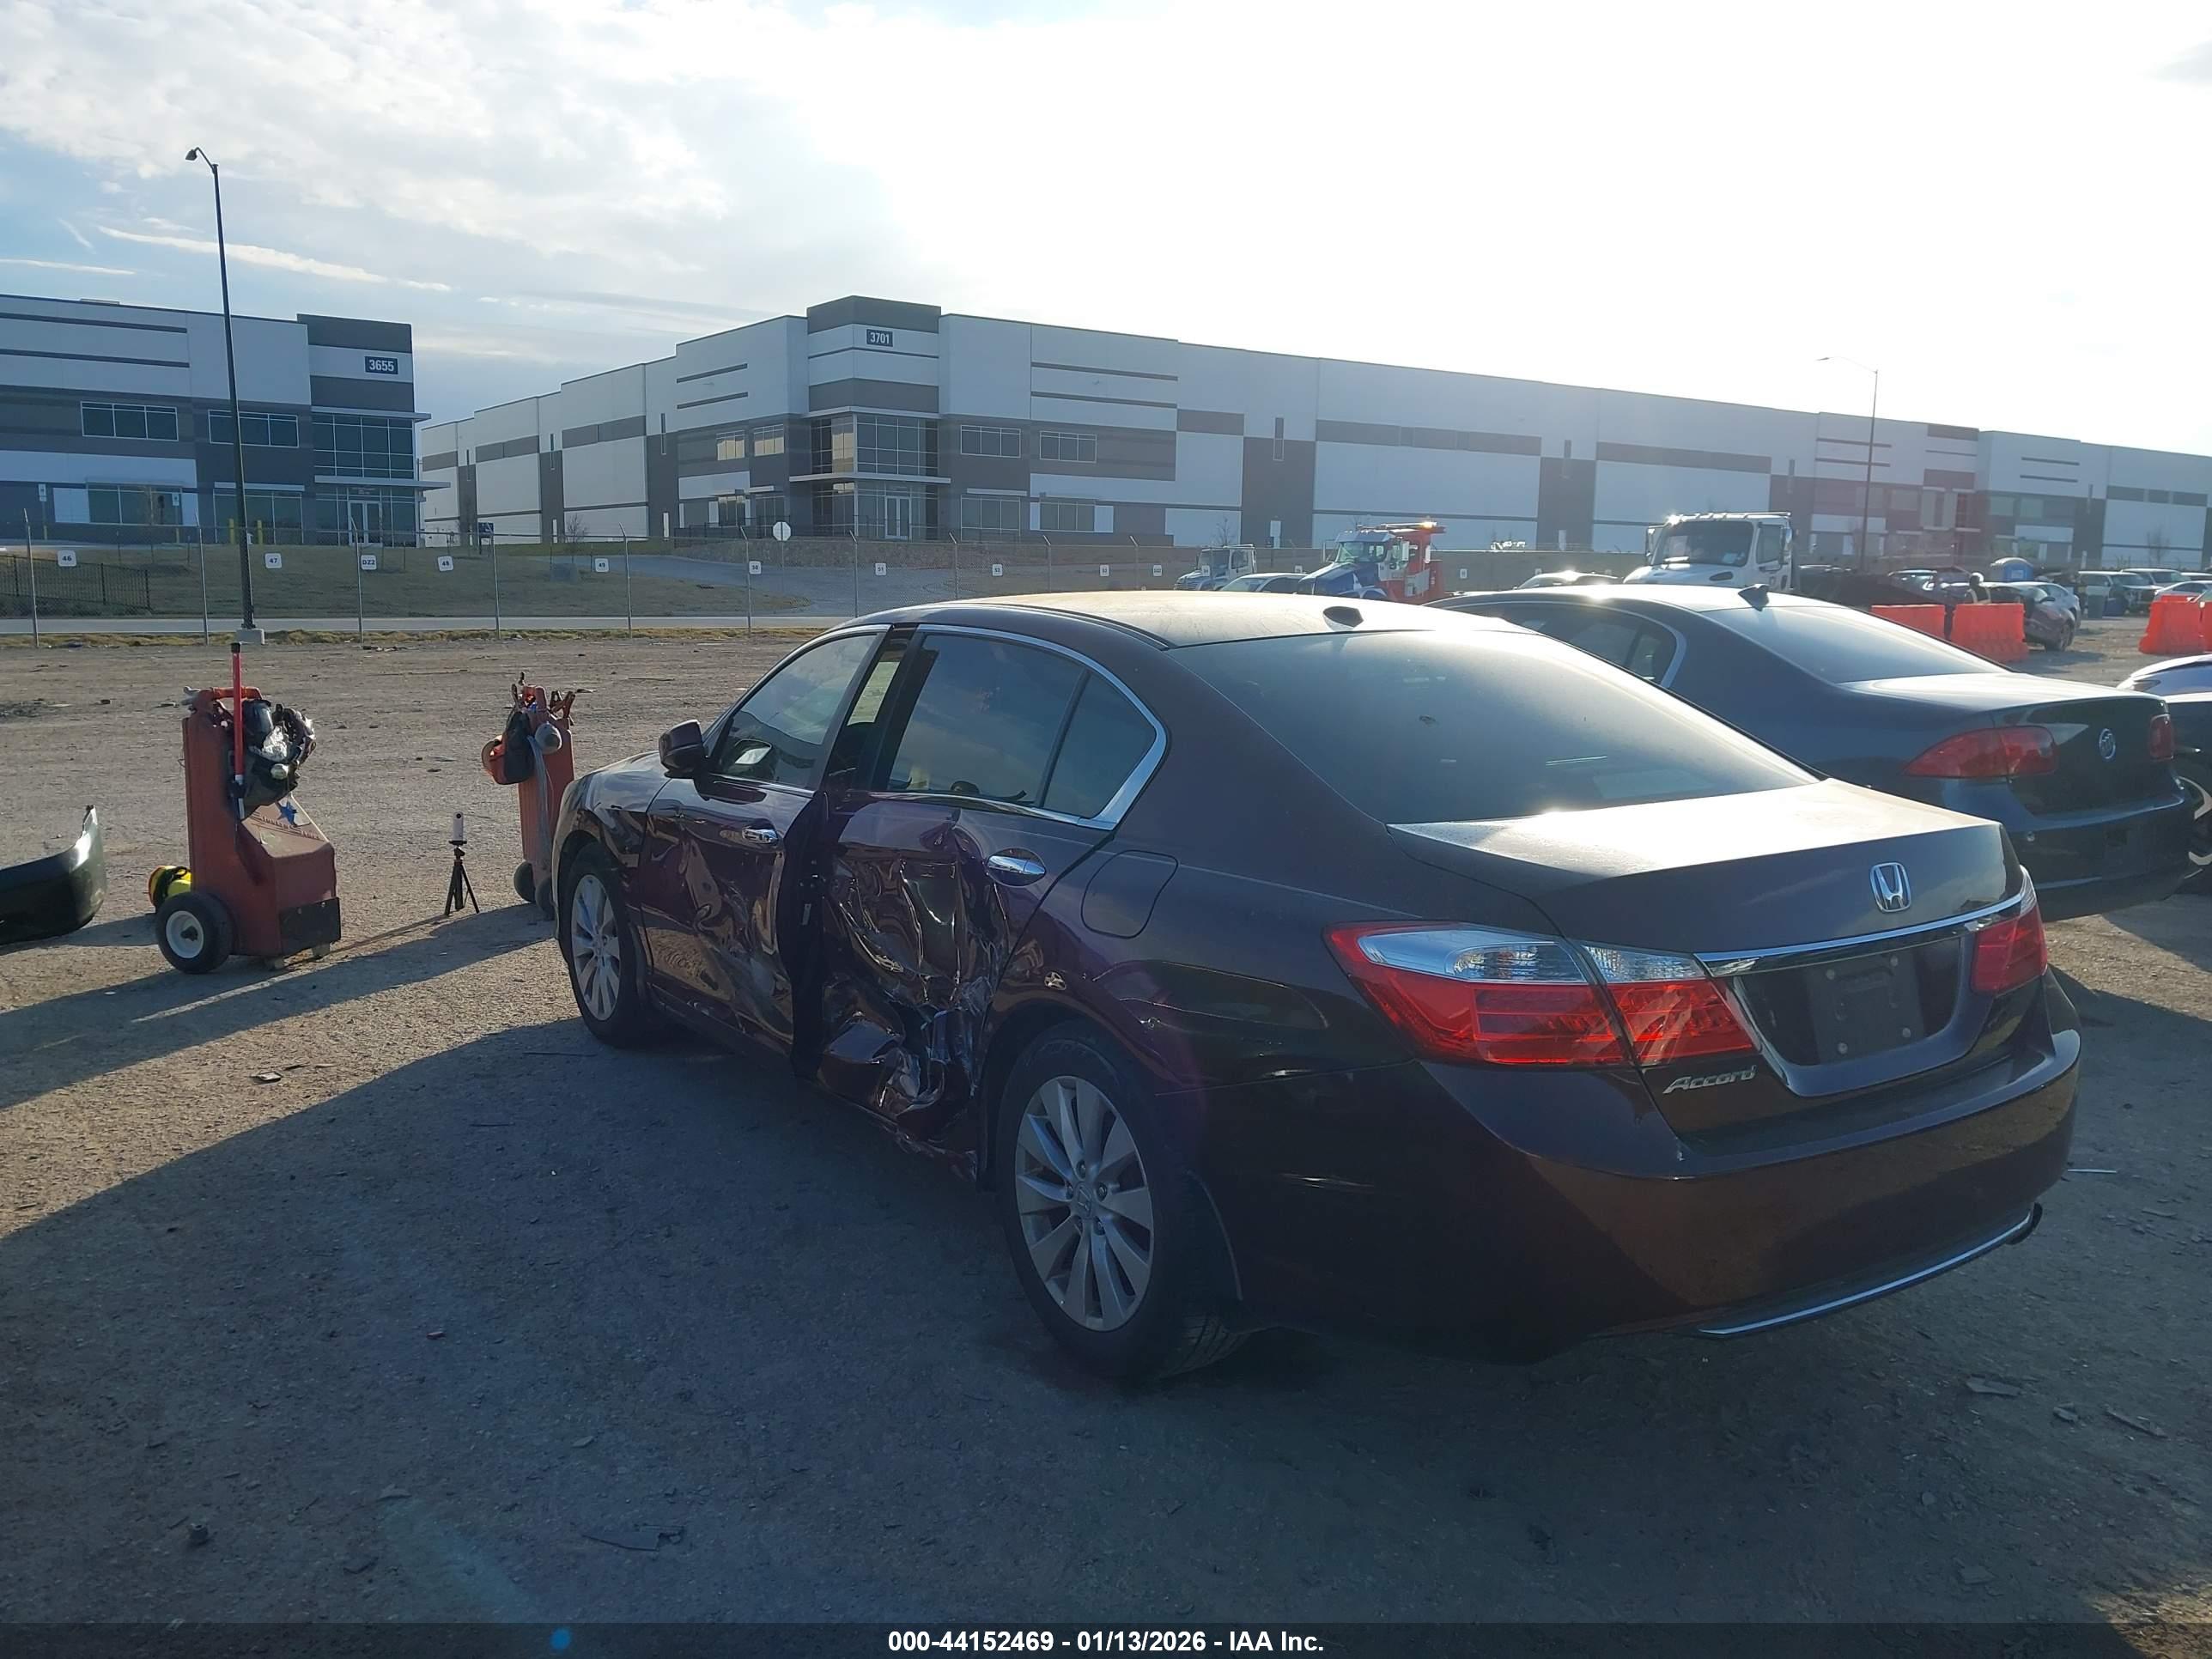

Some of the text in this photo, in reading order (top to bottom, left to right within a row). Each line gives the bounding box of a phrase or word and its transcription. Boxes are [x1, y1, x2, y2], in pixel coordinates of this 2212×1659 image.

[870, 331, 890, 344] 3701
[369, 359, 394, 372] 3655
[1662, 1064, 1757, 1094] Accord
